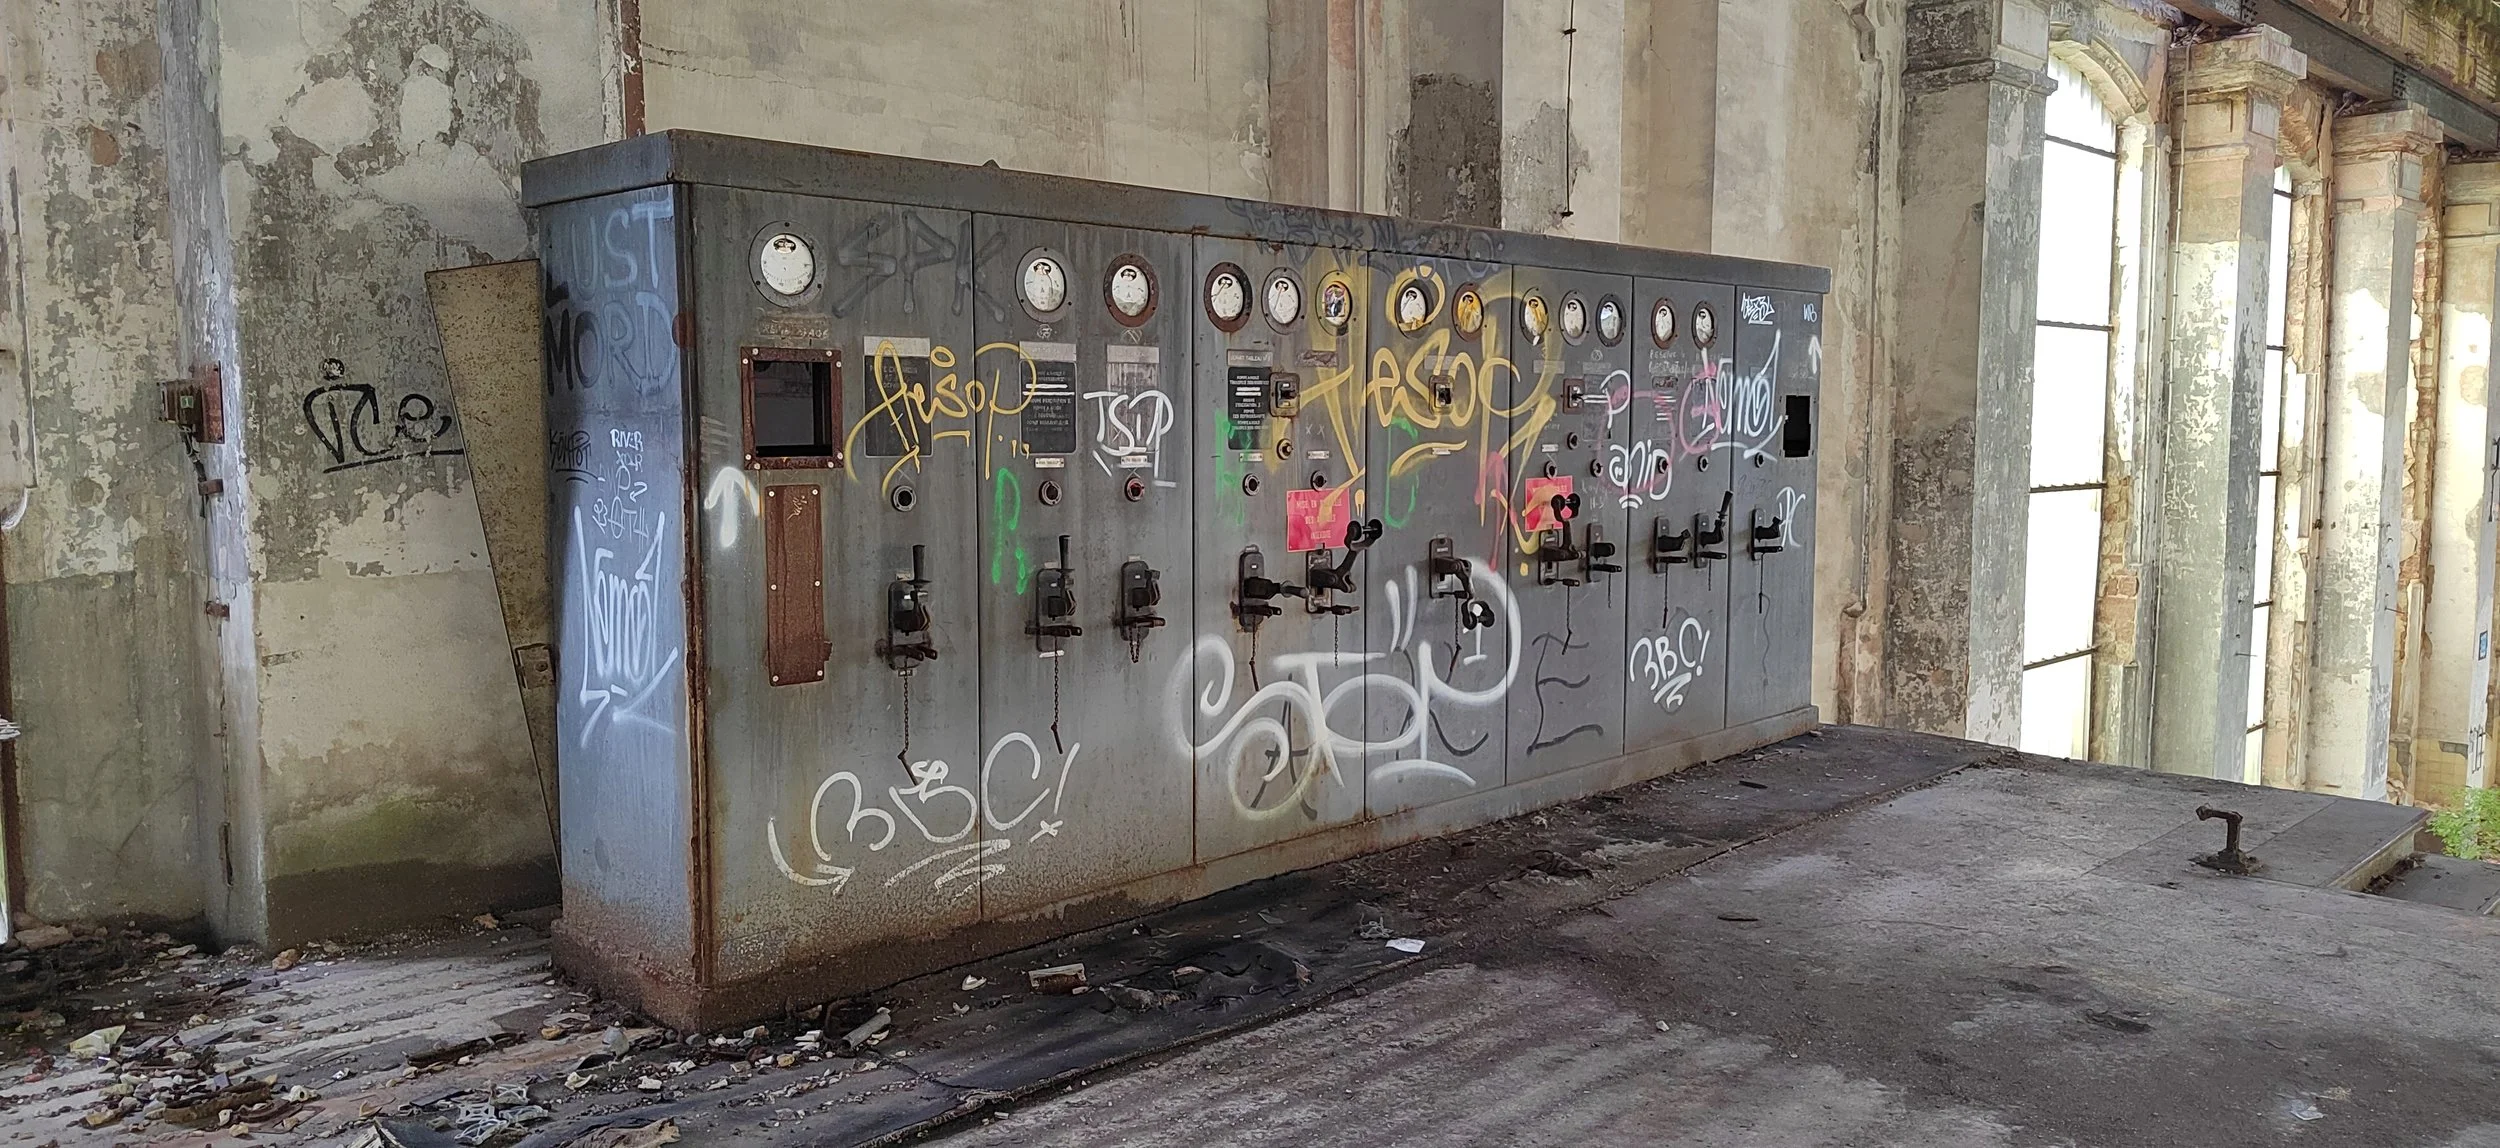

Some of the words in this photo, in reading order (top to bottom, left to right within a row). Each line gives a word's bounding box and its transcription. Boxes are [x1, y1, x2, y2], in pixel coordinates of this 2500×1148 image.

[544, 199, 675, 308] LUST
[831, 210, 1008, 323] SPK
[544, 290, 678, 397] MORD
[609, 428, 644, 452] RIVER
